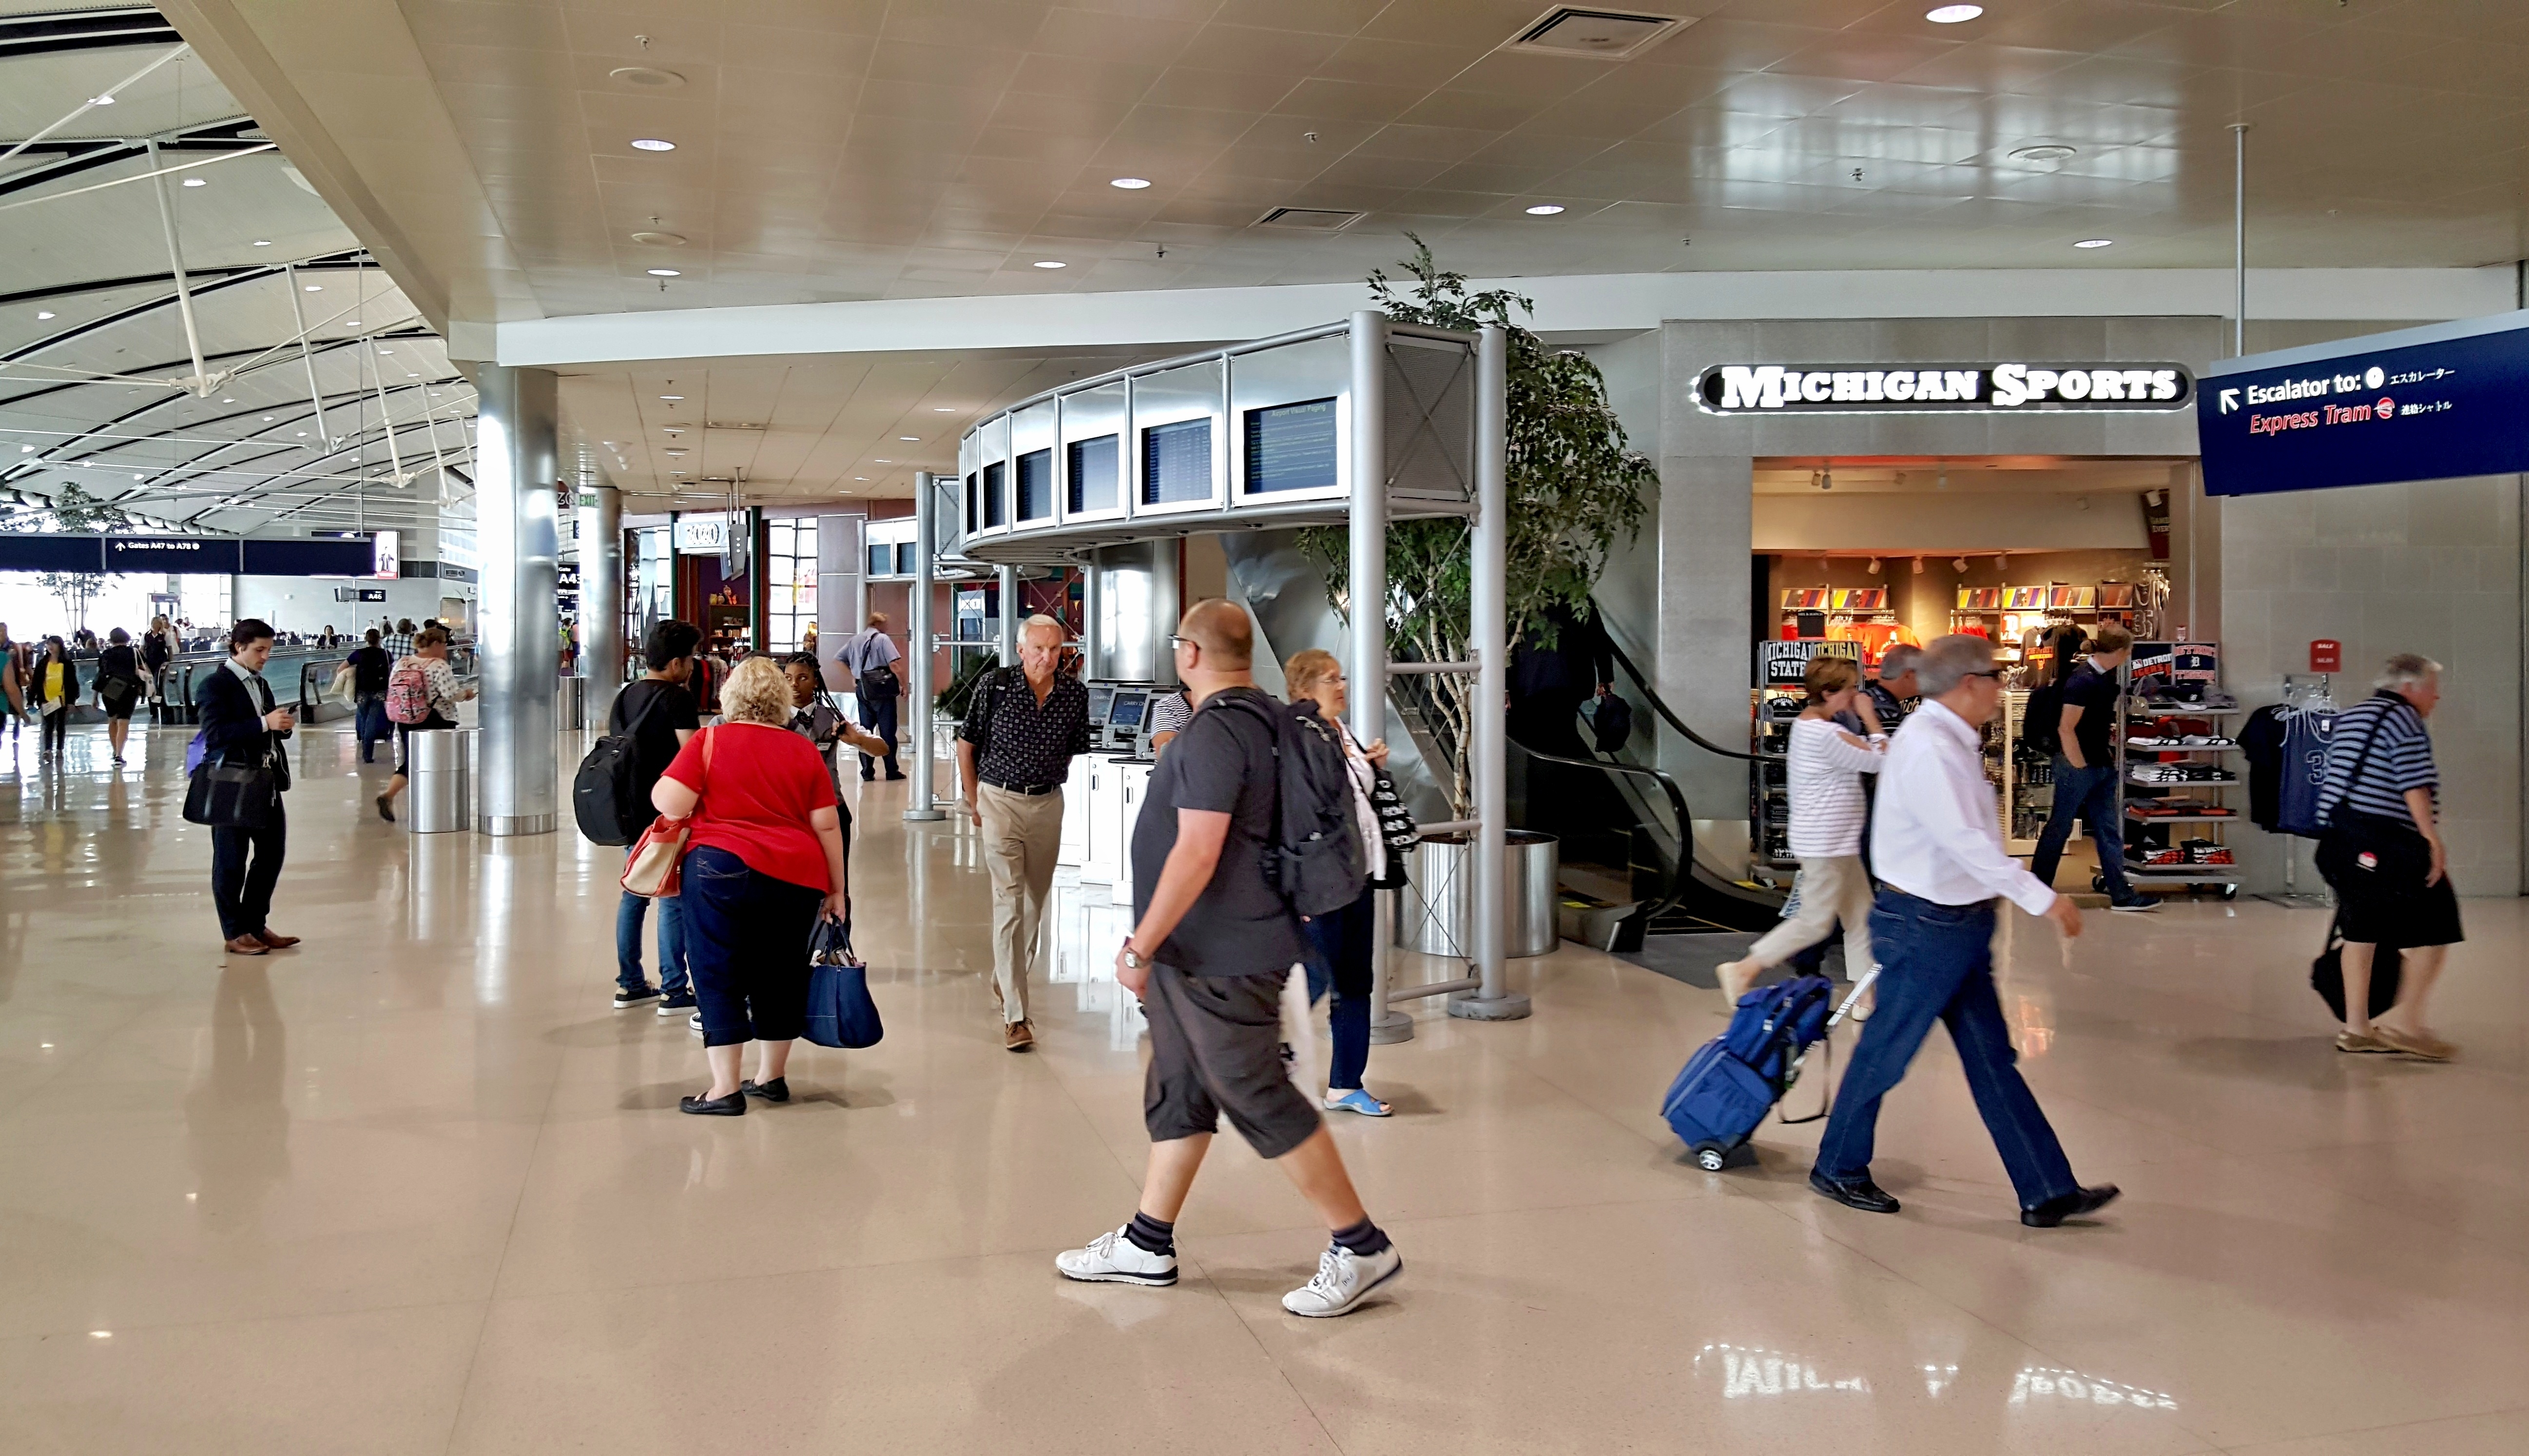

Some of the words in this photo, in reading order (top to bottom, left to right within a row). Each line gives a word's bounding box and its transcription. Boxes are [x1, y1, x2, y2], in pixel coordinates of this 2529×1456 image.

[2390, 368, 2455, 385] エスカレーター
[1721, 366, 1978, 408] MICHIGAN
[1992, 364, 2176, 406] SPORTS
[2248, 379, 2330, 405] Escalator
[2334, 374, 2361, 392] to:
[1271, 410, 1290, 418] Airport
[1307, 404, 1326, 413] Paging
[2250, 411, 2319, 436] Express
[2324, 404, 2372, 425] Tram
[579, 495, 596, 506] EXIT
[1773, 698, 1793, 707] SPARTANS
